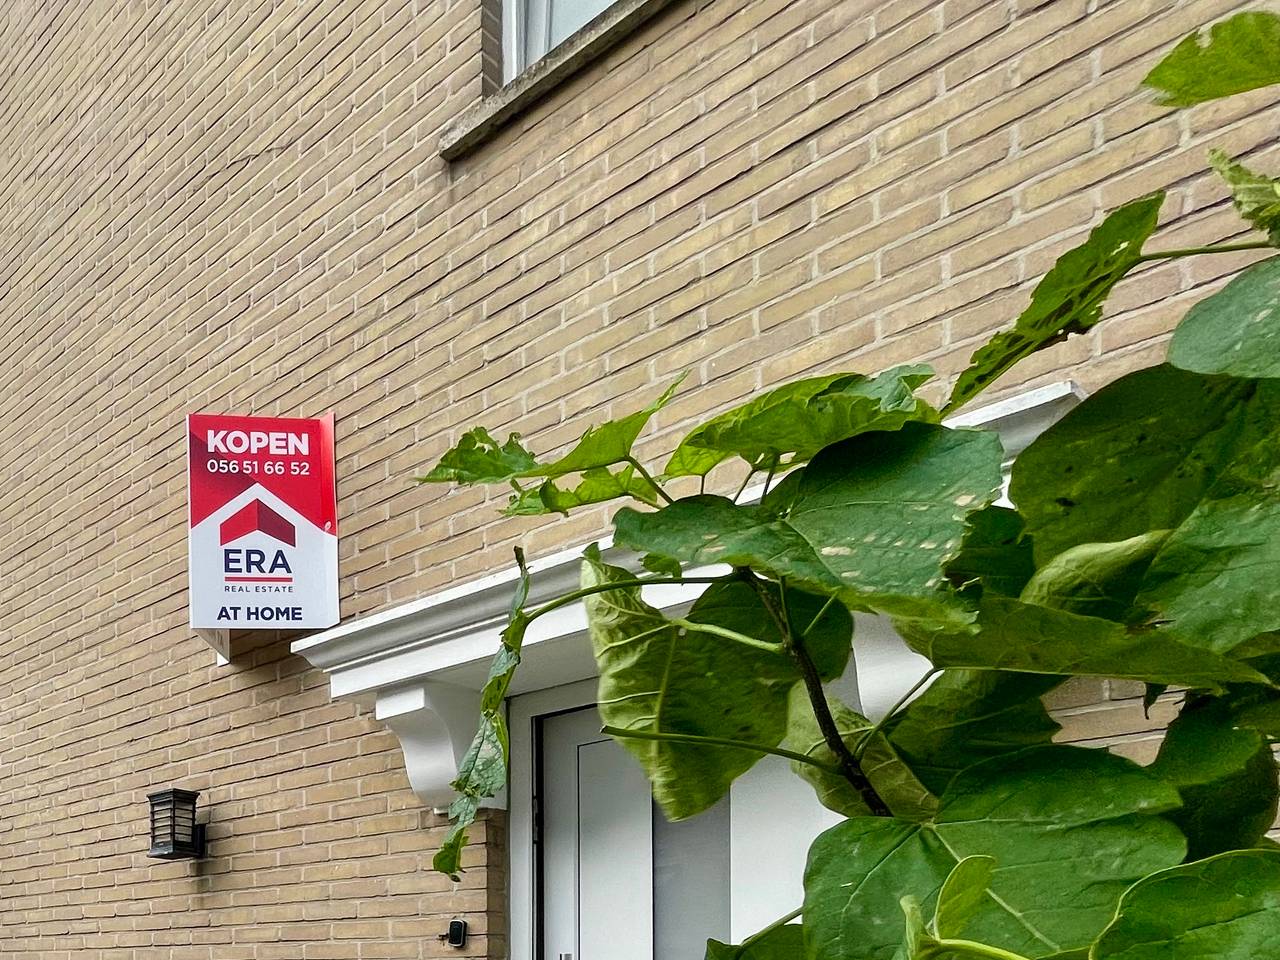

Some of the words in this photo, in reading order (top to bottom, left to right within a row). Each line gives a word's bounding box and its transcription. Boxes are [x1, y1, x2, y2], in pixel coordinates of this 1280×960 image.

[207, 430, 309, 456] KOPEN
[207, 459, 239, 474] 056
[243, 460, 259, 474] 51
[264, 461, 285, 475] 66
[290, 462, 310, 476] 52
[224, 549, 292, 574] ERA
[224, 585, 250, 593] REAL
[217, 606, 241, 621] AT
[247, 607, 303, 621] HOME
